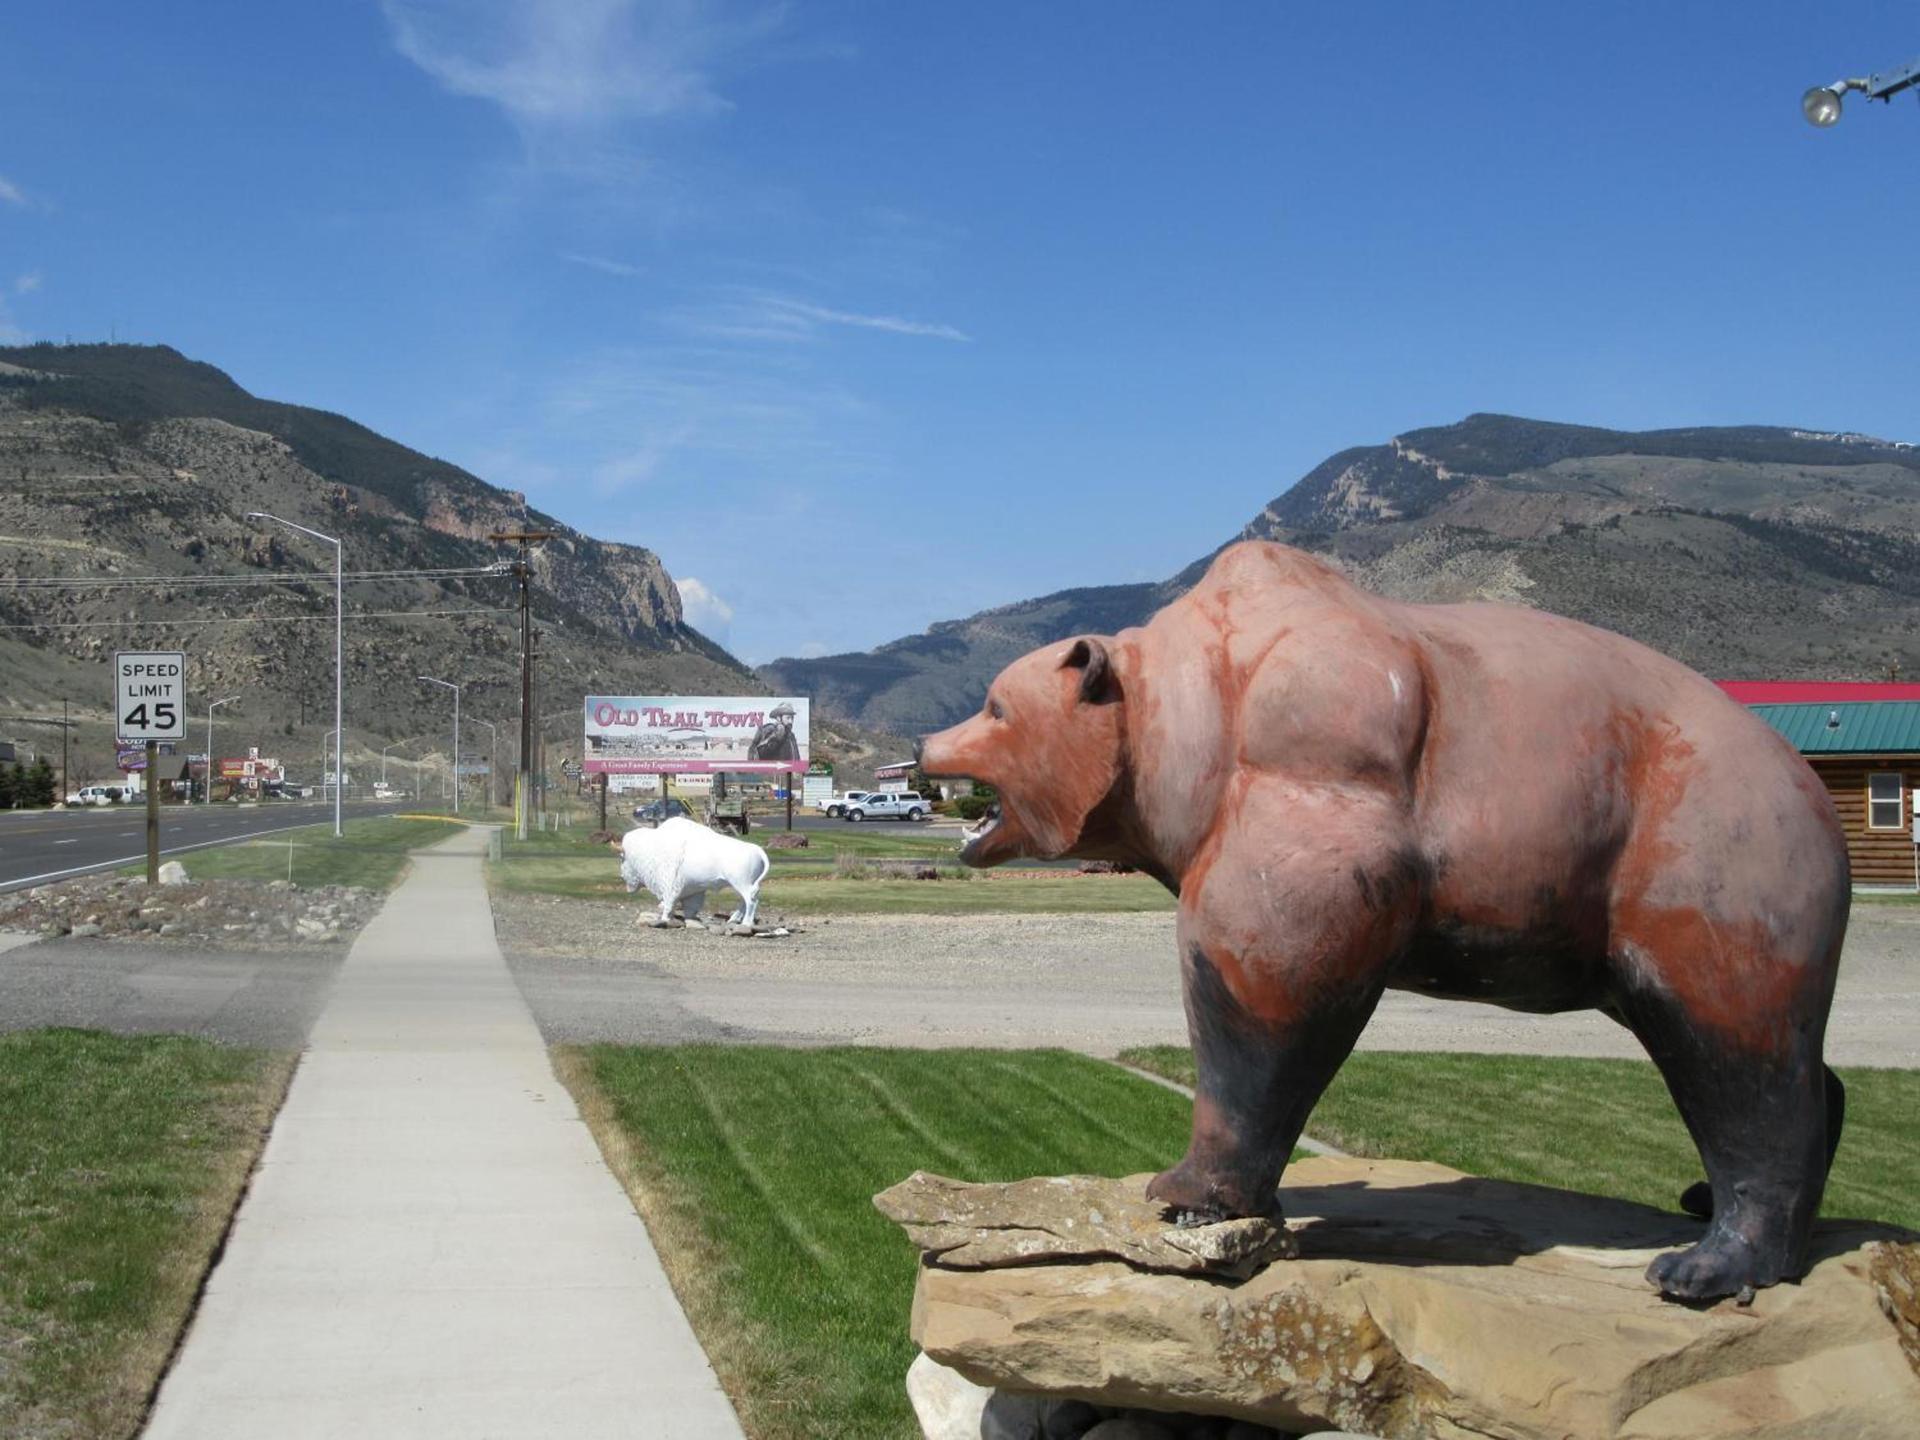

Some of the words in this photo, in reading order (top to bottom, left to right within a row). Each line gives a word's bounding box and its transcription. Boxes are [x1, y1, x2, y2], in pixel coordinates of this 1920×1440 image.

[122, 664, 179, 677] SPEED
[128, 684, 173, 697] LIMIT
[124, 703, 176, 730] 45
[594, 703, 639, 727] OLD
[641, 707, 704, 728] TRAIL
[705, 711, 765, 728] TOWN
